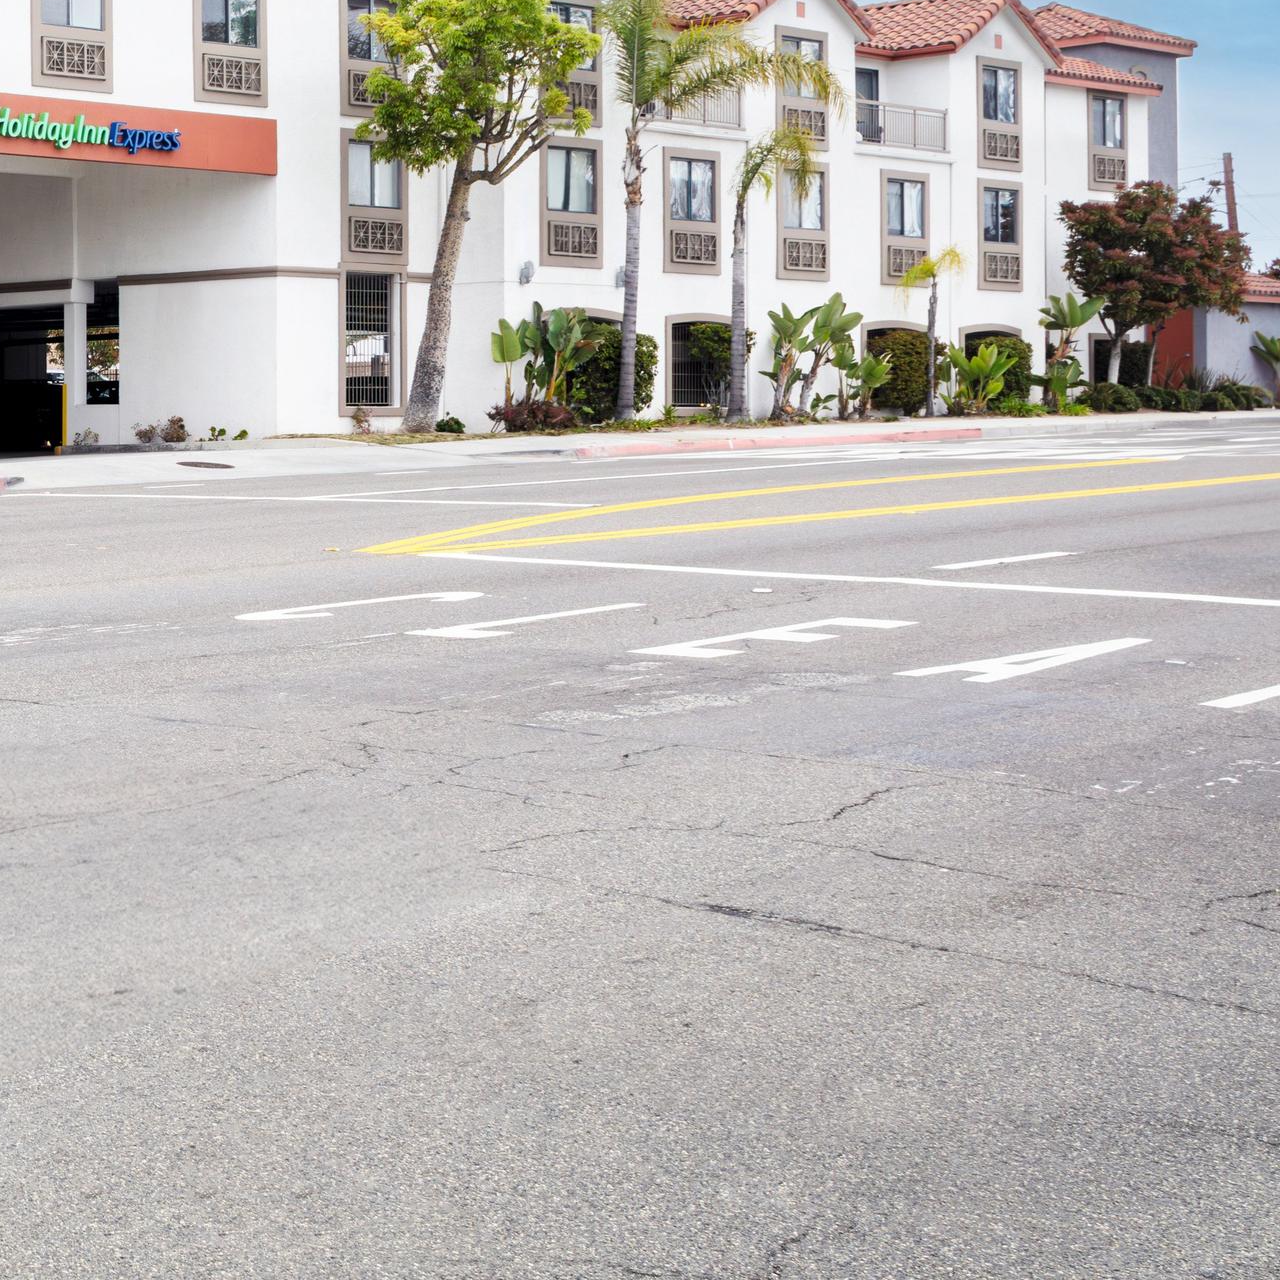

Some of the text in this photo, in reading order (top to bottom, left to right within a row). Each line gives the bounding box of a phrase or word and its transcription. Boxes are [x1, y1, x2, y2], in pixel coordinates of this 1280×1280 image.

[75, 114, 110, 146] Inn
[110, 121, 182, 154] Express
[234, 590, 1280, 709] CLEA
